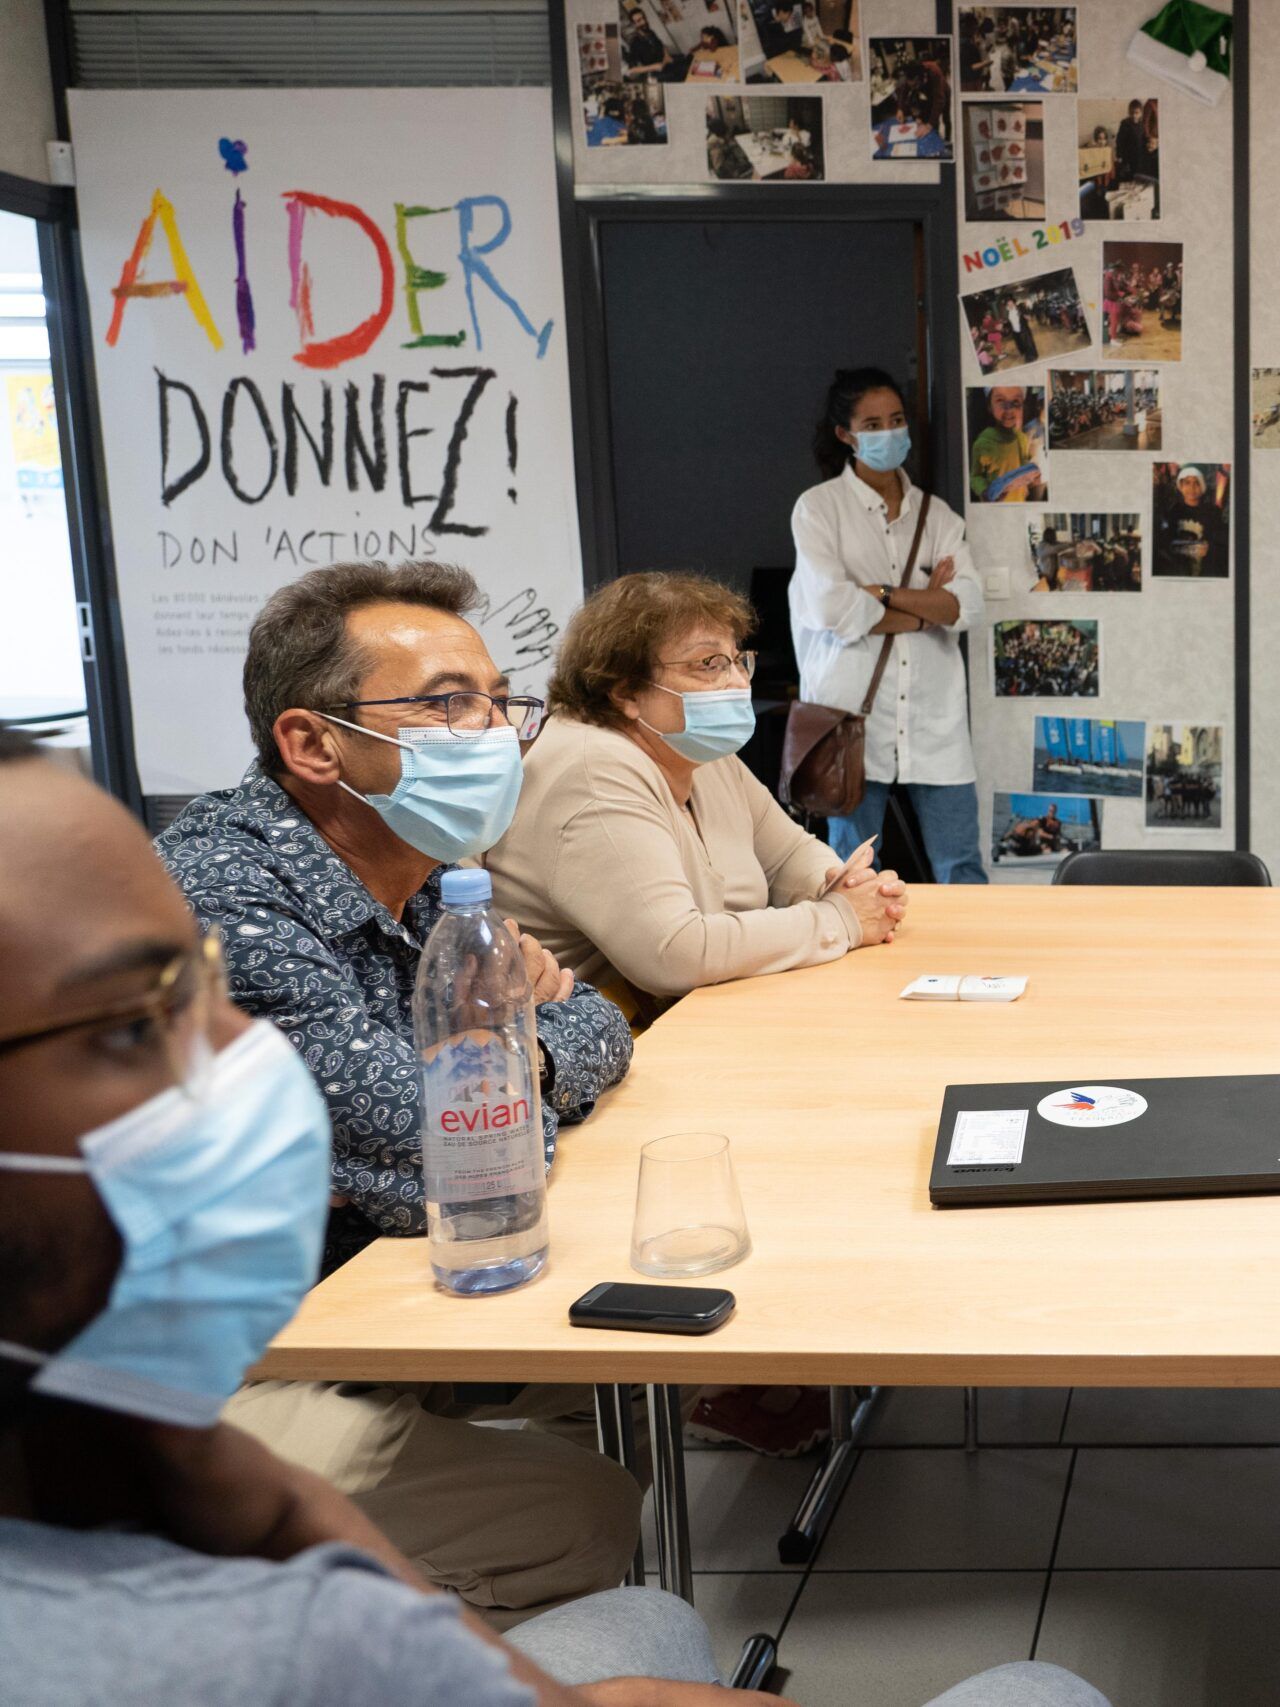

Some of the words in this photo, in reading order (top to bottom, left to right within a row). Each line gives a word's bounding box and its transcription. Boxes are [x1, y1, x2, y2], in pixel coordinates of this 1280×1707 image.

[963, 236, 1030, 273] NOËL
[1032, 218, 1085, 250] 2019
[158, 530, 239, 569] DON
[441, 1099, 528, 1133] evian
